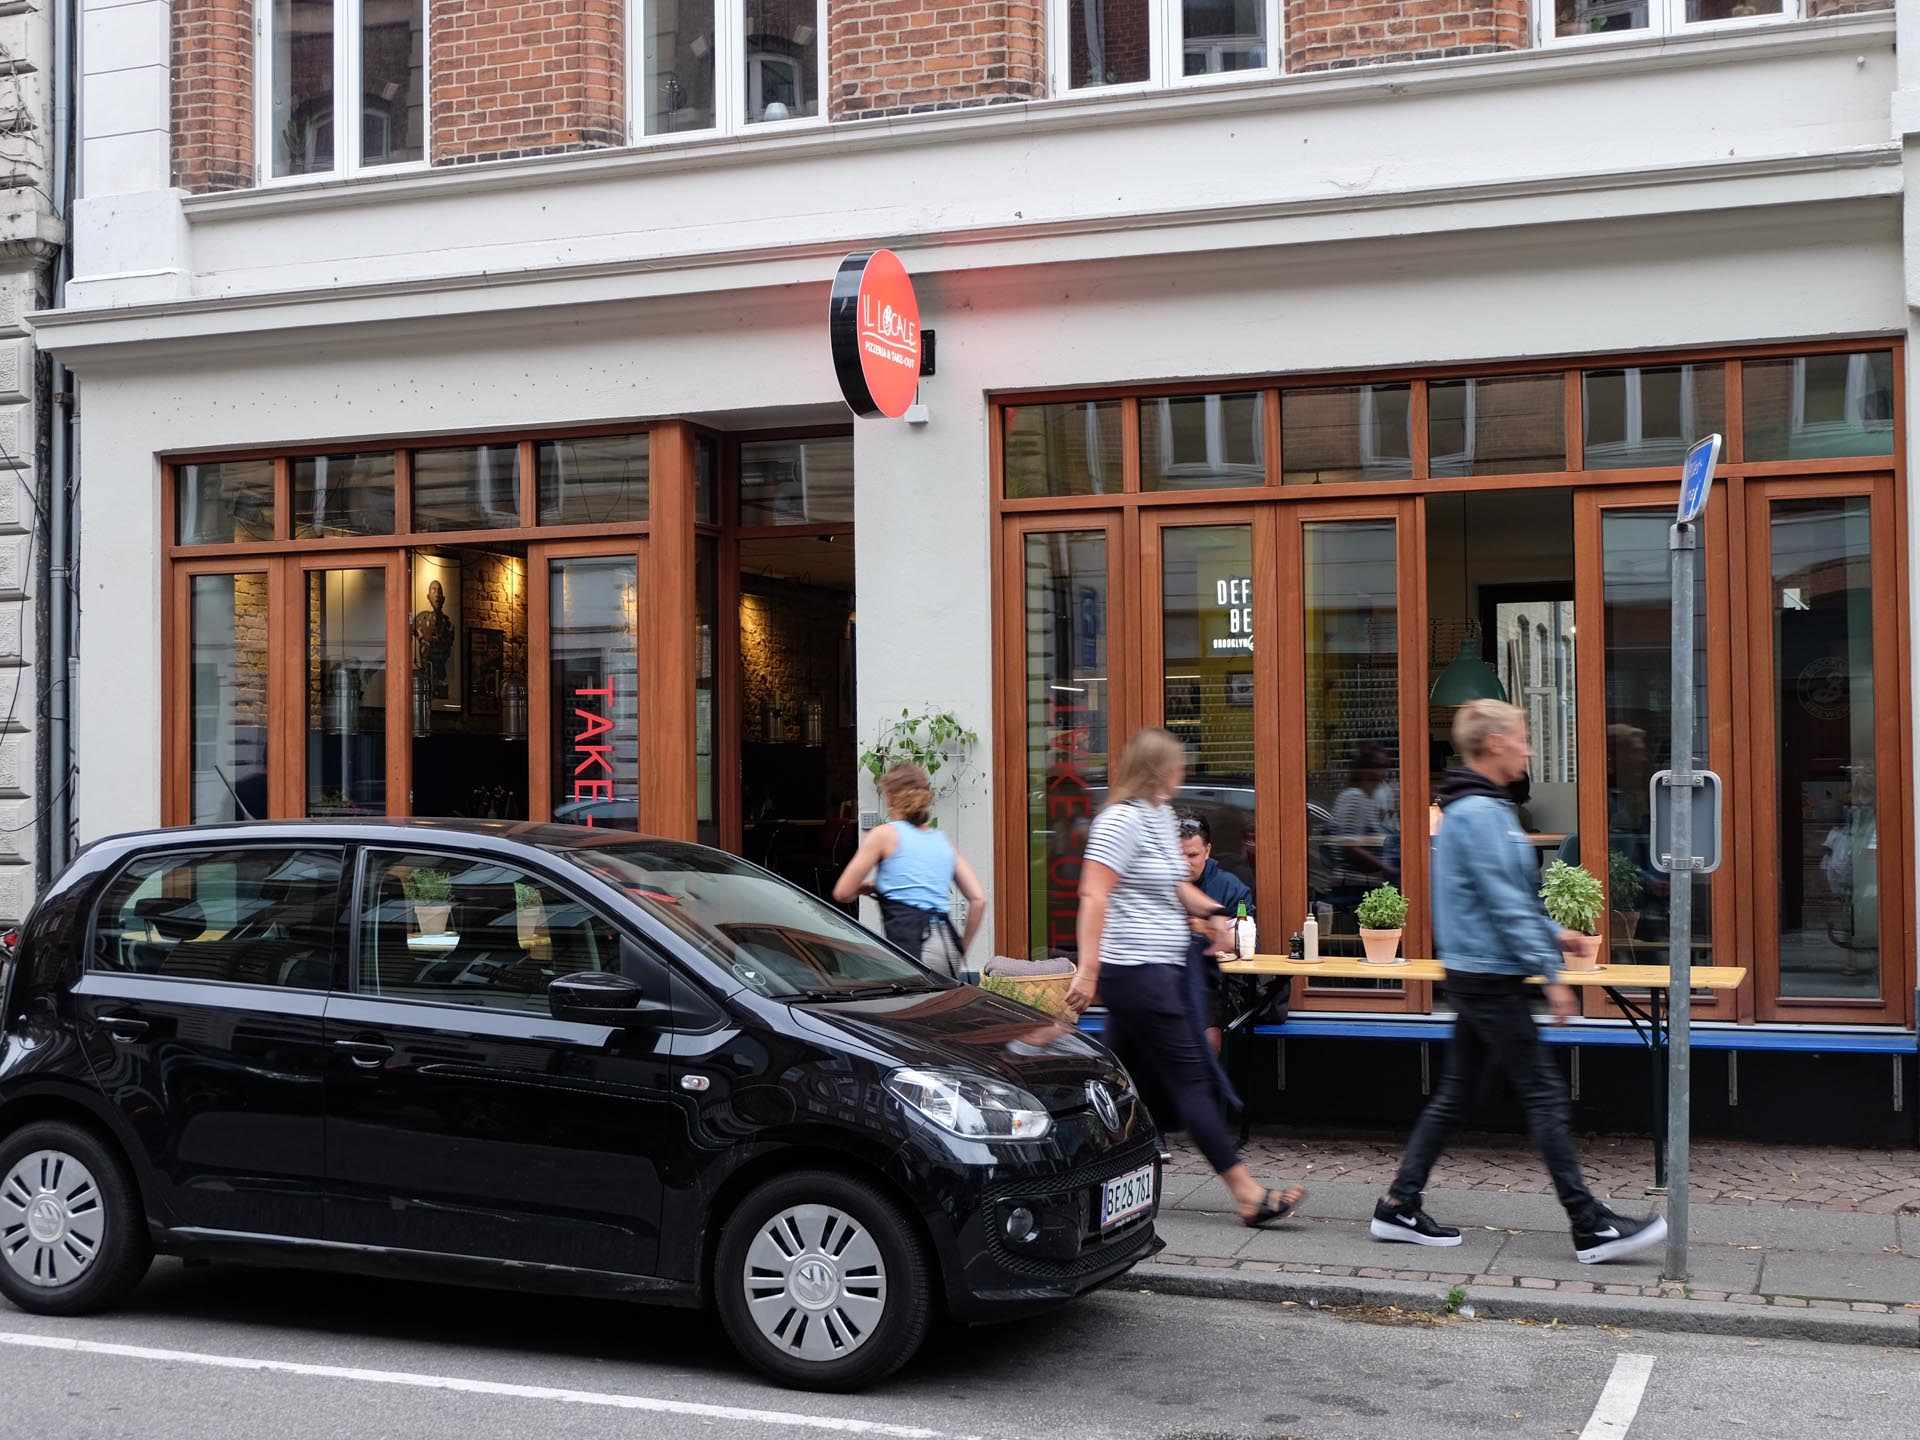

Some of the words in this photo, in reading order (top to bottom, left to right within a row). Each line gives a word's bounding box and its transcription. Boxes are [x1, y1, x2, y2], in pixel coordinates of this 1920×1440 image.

[863, 294, 874, 327] IL
[878, 300, 917, 346] LOCALE
[865, 340, 887, 359] PIZZERIA
[891, 351, 915, 369] TAKE-OUT
[1217, 580, 1251, 605] DEF
[1230, 608, 1252, 633] BE
[1136, 1172, 1150, 1204] 781
